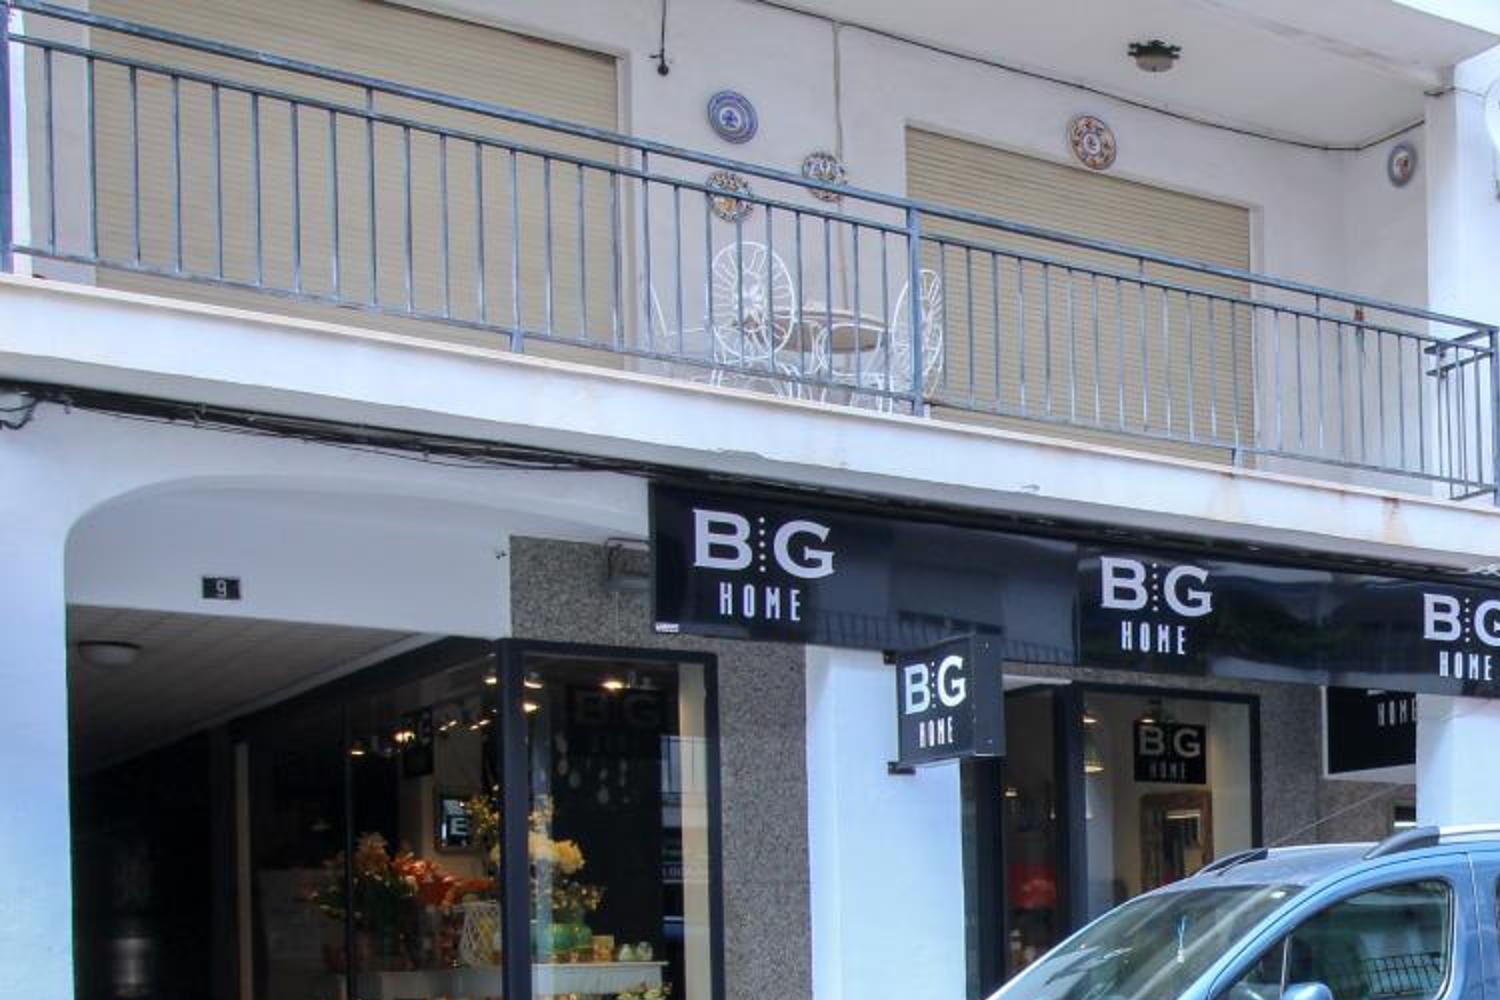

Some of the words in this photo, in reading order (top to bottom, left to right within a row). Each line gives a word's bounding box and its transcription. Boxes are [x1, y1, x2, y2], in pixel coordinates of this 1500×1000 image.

[215, 579, 227, 600] 9
[719, 582, 801, 622] HOME
[1120, 621, 1187, 656] HOME
[1438, 650, 1493, 681] HOME
[919, 716, 954, 749] HOME
